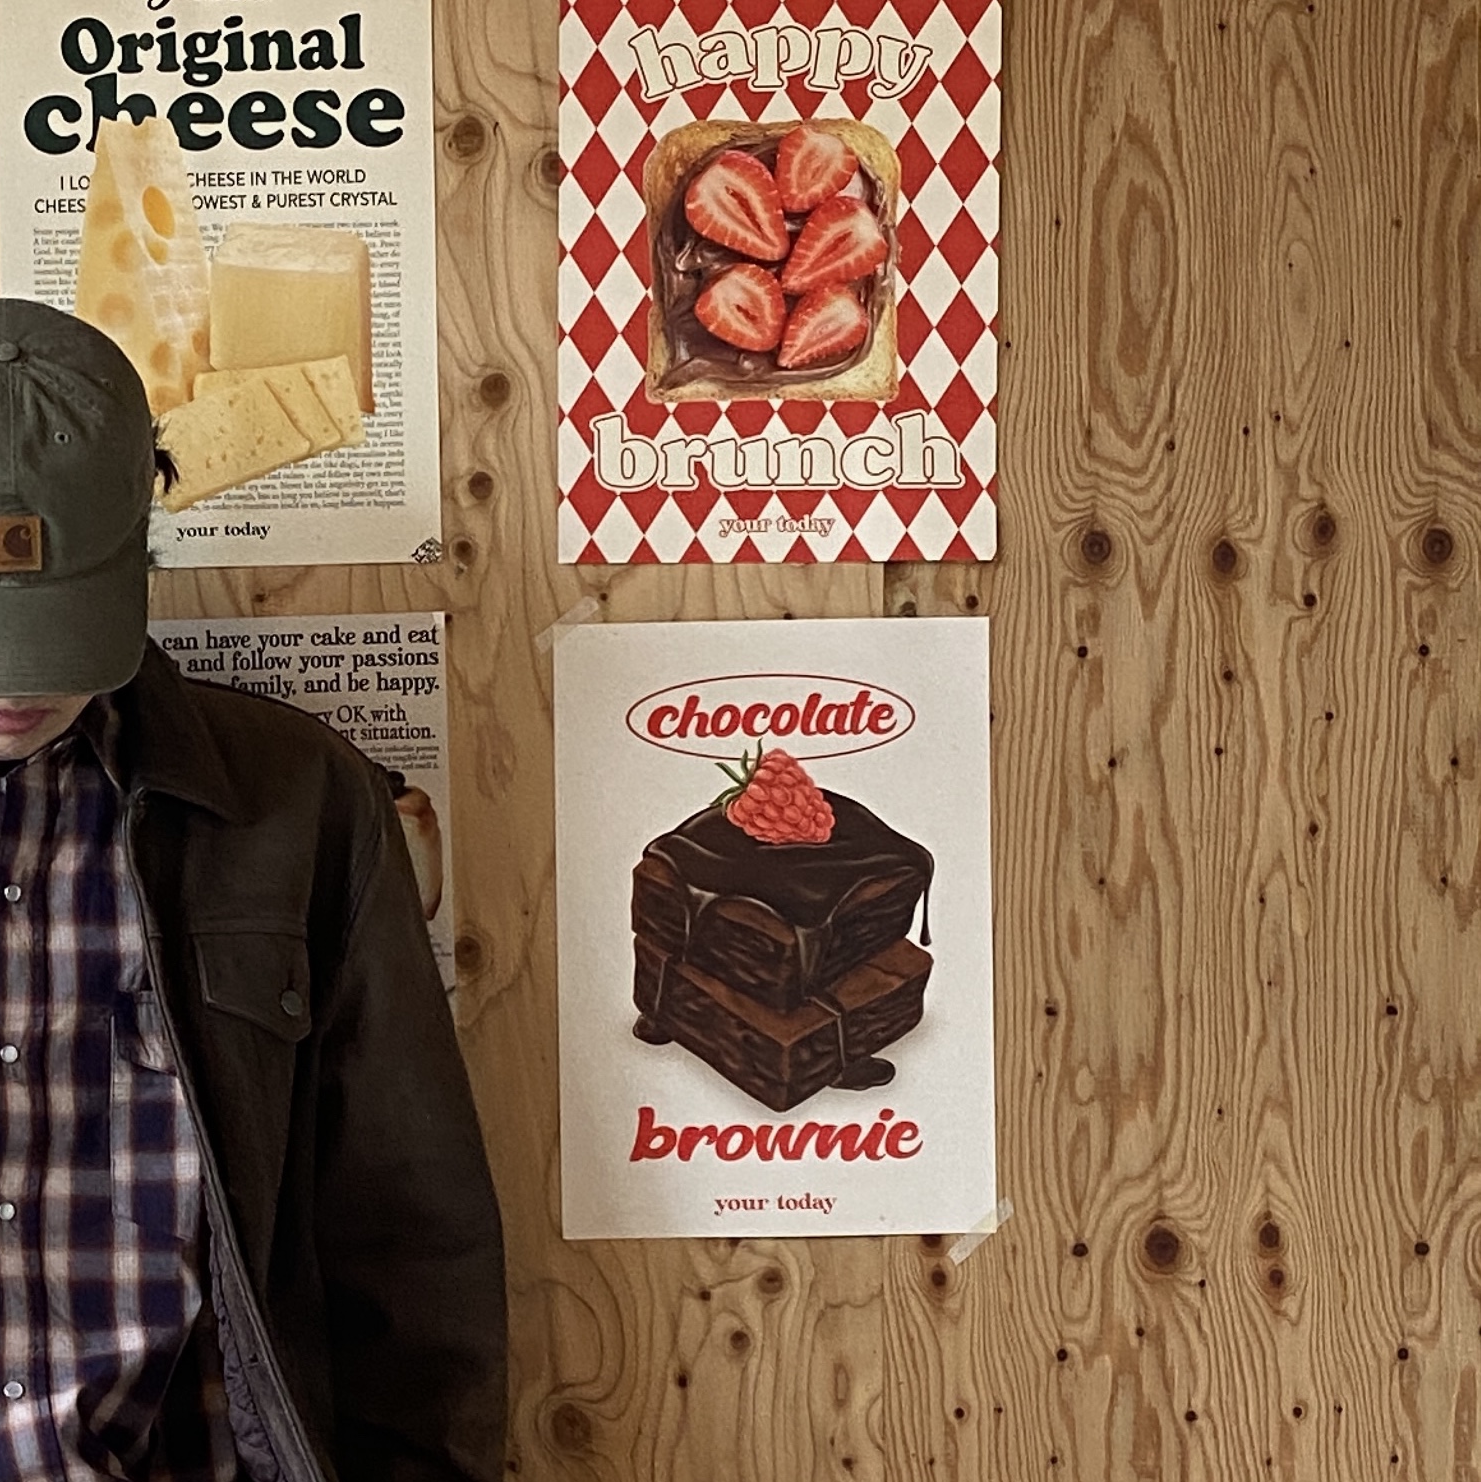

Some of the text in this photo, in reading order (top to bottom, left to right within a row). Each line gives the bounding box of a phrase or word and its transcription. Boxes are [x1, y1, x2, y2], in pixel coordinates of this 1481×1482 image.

[60, 12, 366, 87] Original
[629, 24, 932, 102] happy
[59, 175, 90, 192] I LO
[250, 171, 267, 187] IN
[270, 170, 303, 186] THE
[306, 168, 367, 185] WORLD
[34, 198, 86, 214] CHEES
[192, 190, 399, 211] OWEST & PUREST CRYSTAL
[590, 409, 964, 491] brunch
[176, 521, 271, 542] your today
[719, 513, 835, 536] your today
[162, 624, 440, 653] can have your cake and eat
[187, 646, 439, 674] and follow your passions
[304, 672, 342, 693] and
[347, 671, 370, 692] be
[376, 671, 440, 696] happy.
[337, 705, 368, 723] OK
[370, 703, 407, 722] with
[646, 690, 898, 740] chocolate
[360, 722, 436, 741] situation.
[628, 1105, 924, 1163] brownie
[713, 1192, 836, 1216] your today
